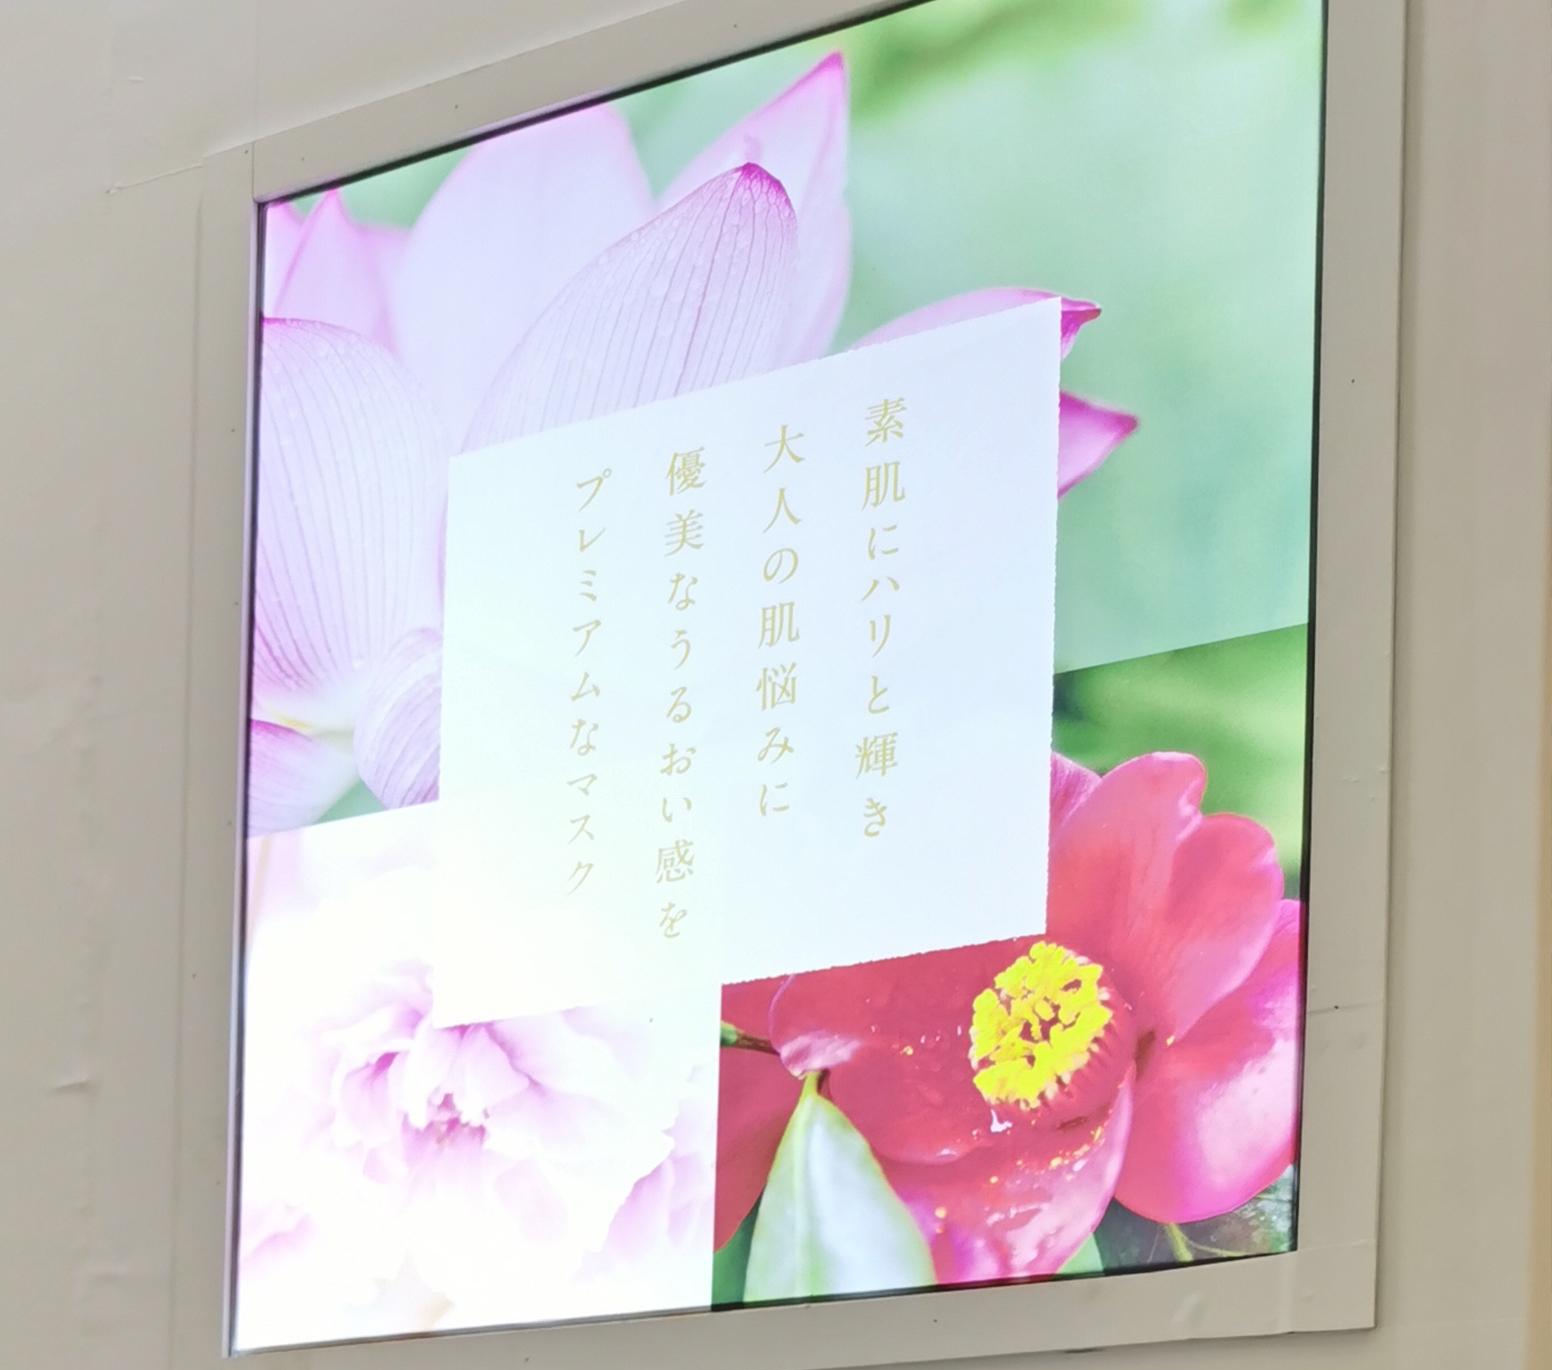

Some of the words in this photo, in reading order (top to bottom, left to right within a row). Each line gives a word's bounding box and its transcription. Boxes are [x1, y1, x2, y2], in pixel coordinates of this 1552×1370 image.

[565, 467, 613, 896] プレミアムなマスク
[655, 445, 707, 939] 優美なうるおい感を
[755, 424, 806, 817] 大人の肌悩みに
[855, 396, 907, 838] 素肌にハリと輝き
